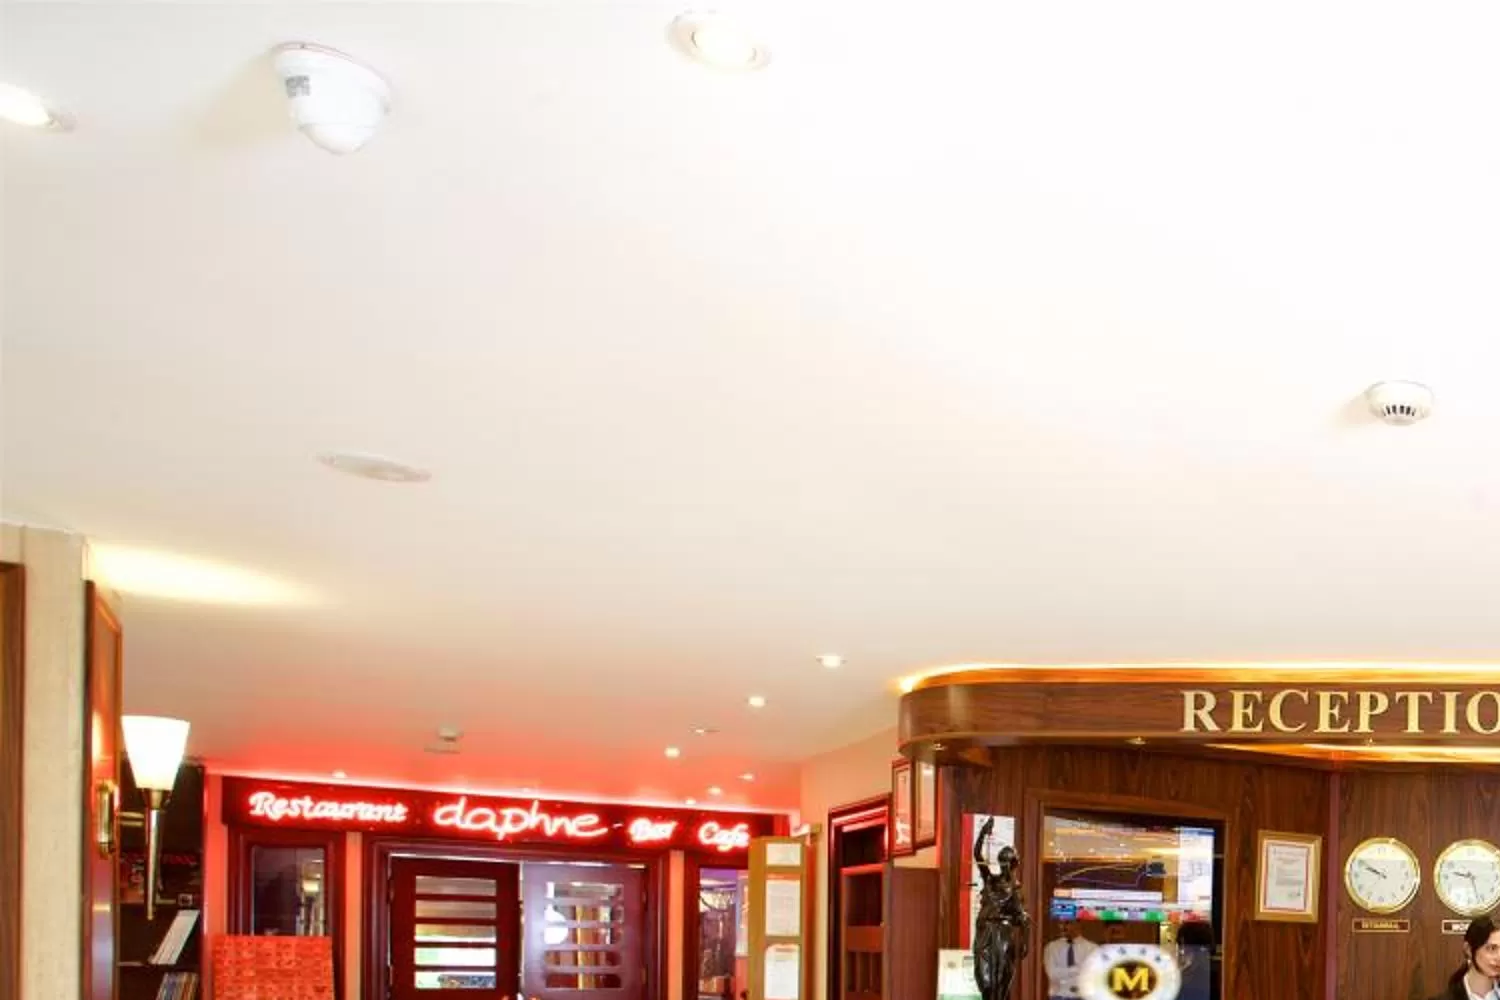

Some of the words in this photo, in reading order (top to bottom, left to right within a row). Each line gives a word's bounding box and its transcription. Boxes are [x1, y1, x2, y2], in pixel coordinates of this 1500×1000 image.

[248, 791, 408, 823] Restaurant
[433, 796, 609, 840] daphne
[628, 815, 678, 842] Bar
[1112, 967, 1150, 992] M
